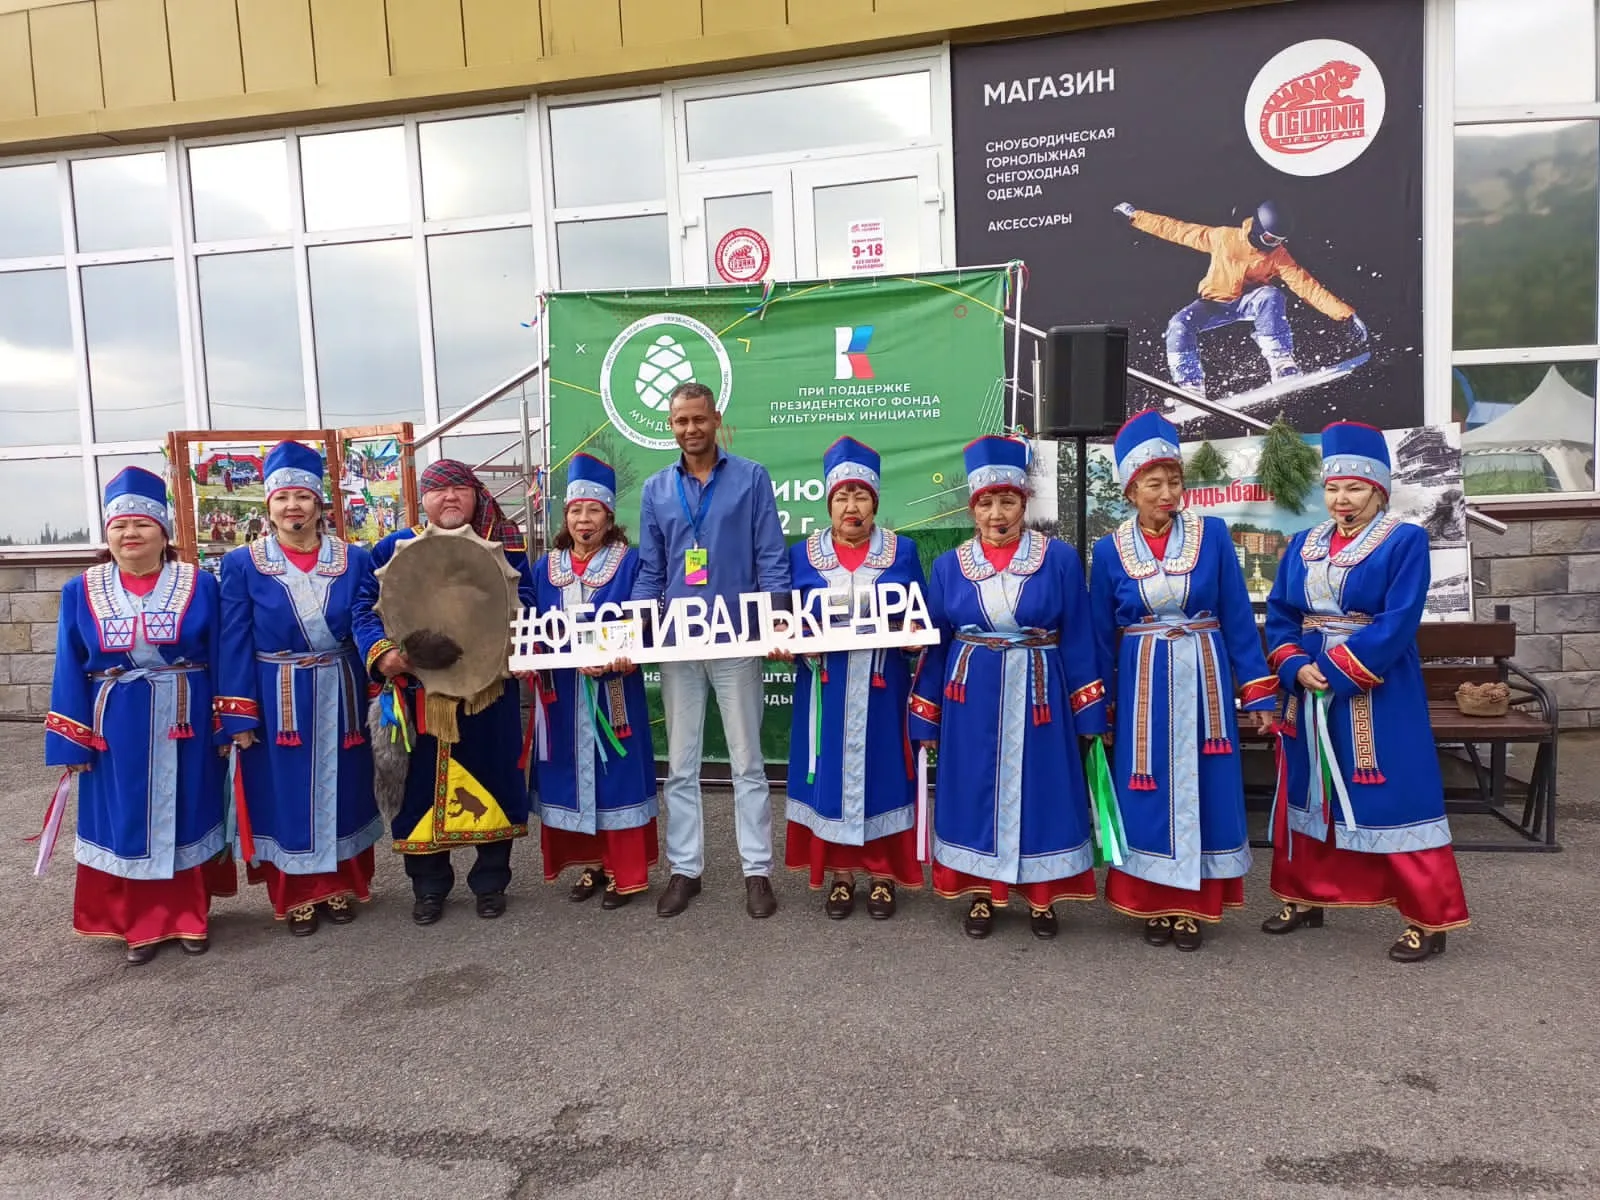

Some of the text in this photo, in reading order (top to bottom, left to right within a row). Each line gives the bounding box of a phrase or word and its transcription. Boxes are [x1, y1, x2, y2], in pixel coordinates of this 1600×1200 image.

[984, 68, 1115, 106] МАГАЗИН
[1275, 103, 1365, 137] IGUANA
[985, 127, 1116, 153] СНОУБОРДИЧЕСКАЯ
[1279, 130, 1361, 145] LIFE WEAR
[986, 147, 1086, 169] ГОРНОЛЫЖНАЯ
[986, 164, 1080, 184] СНЕГОХОДНАЯ
[987, 185, 1043, 201] ОДЕЖДА
[988, 213, 1073, 232] АКСЕССУАРЫ
[852, 243, 883, 258] 9-18
[799, 383, 912, 397] ПРИ ПОДДЕРЖКЕ
[770, 395, 941, 411] ПРЕЗИДЕНТСКОГО ФОНДА
[770, 408, 941, 424] КУЛЬТУРНЫХ ИНИЦИАТИВ
[777, 510, 790, 534] 2
[509, 581, 934, 658] #ФЕСТИВАЛЬКЕДРА
